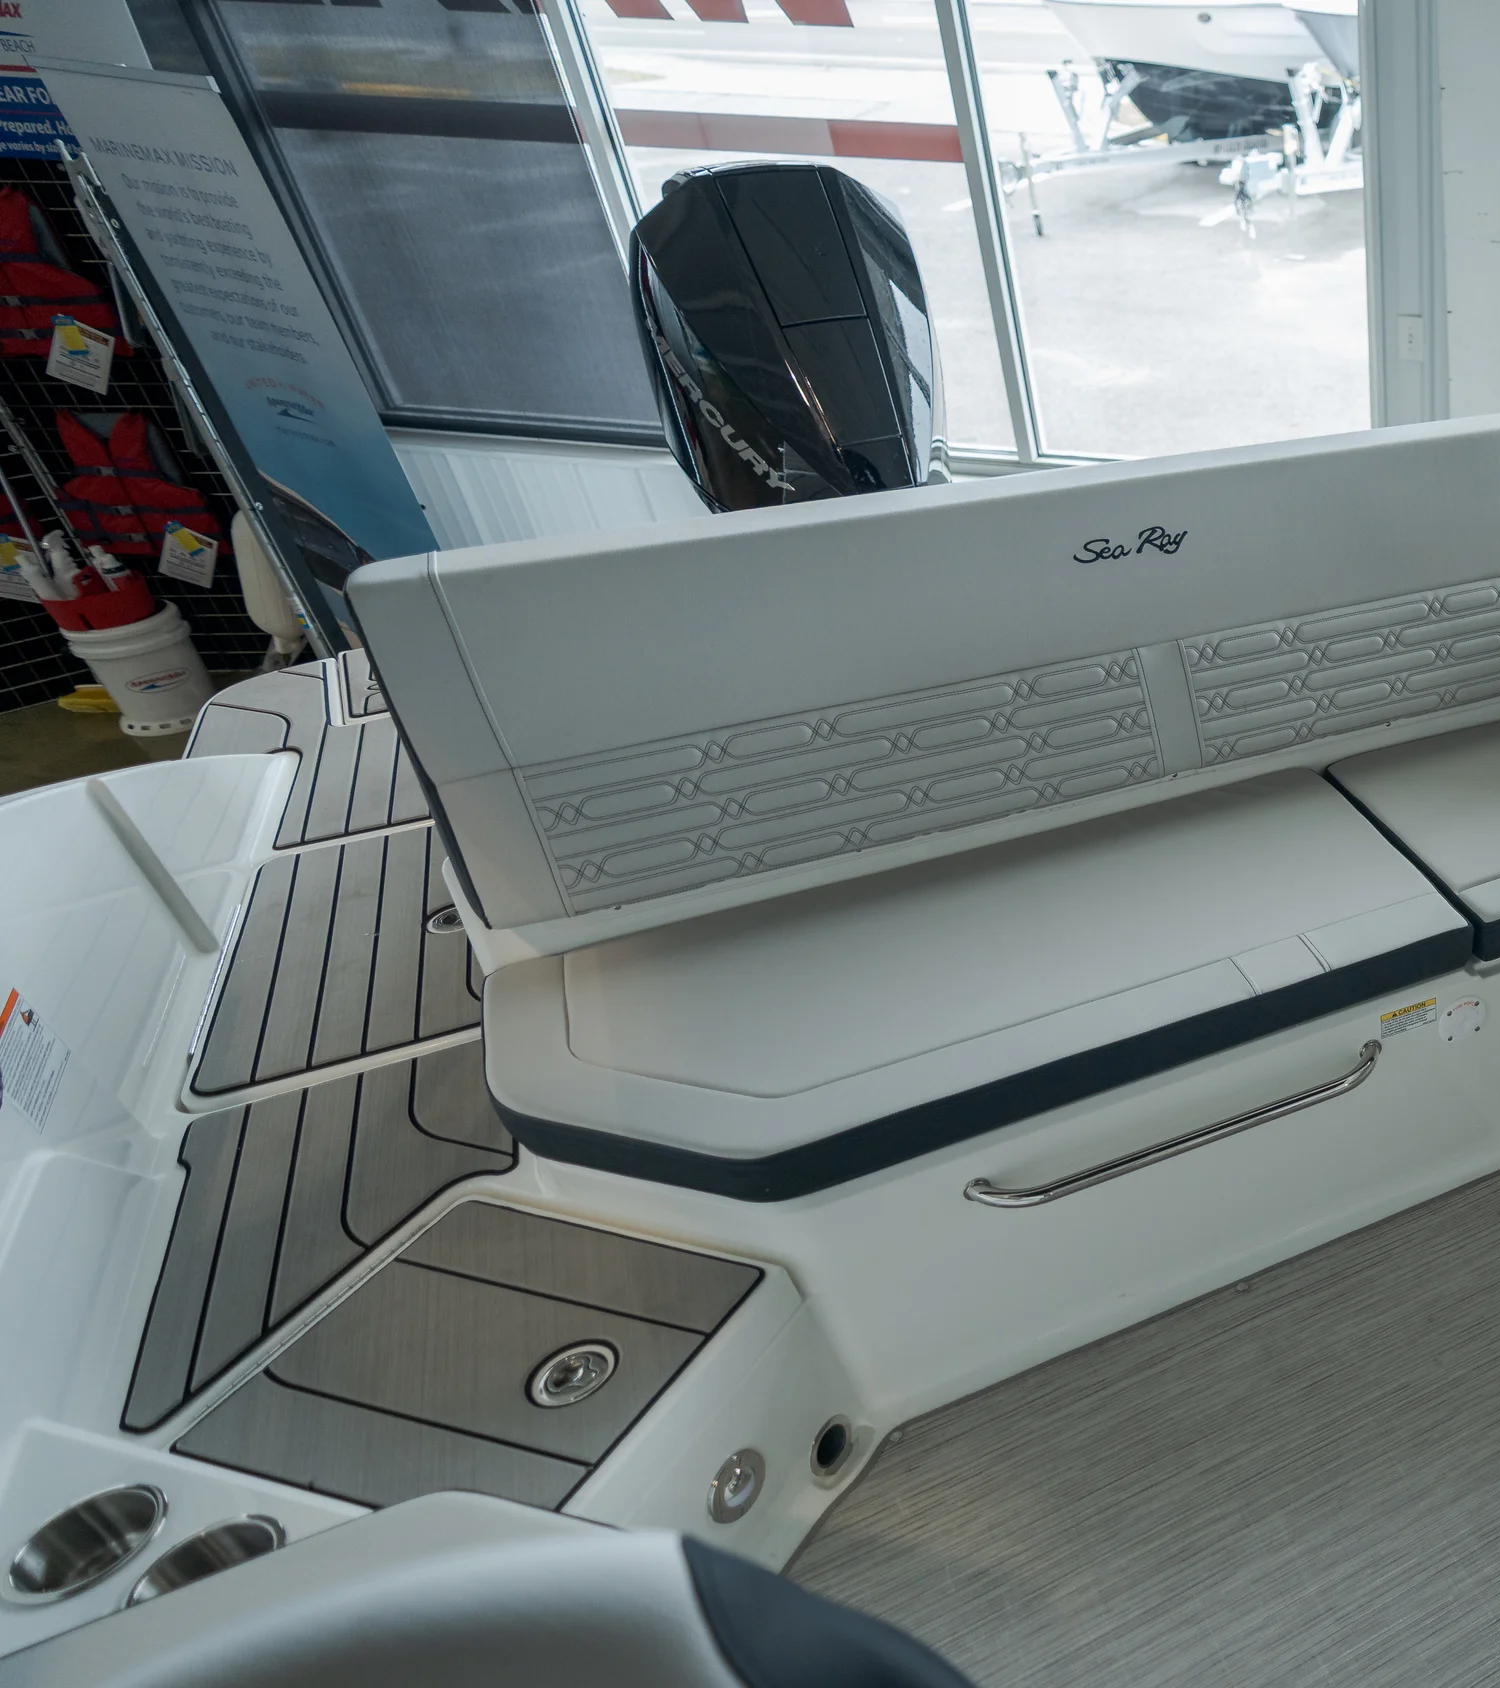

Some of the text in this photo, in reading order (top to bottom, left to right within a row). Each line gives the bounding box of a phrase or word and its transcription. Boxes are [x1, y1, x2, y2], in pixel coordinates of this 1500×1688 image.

[1, 38, 36, 53] BEACH
[25, 86, 50, 105] FO
[89, 136, 239, 177] MARINEMAX MISSION
[211, 217, 253, 240] boating
[255, 248, 273, 268] by
[262, 273, 284, 291] the
[280, 304, 299, 317] our
[647, 318, 796, 492] MERCURY
[1073, 526, 1188, 564] Sea Ray
[1398, 1002, 1427, 1015] CAUTION
